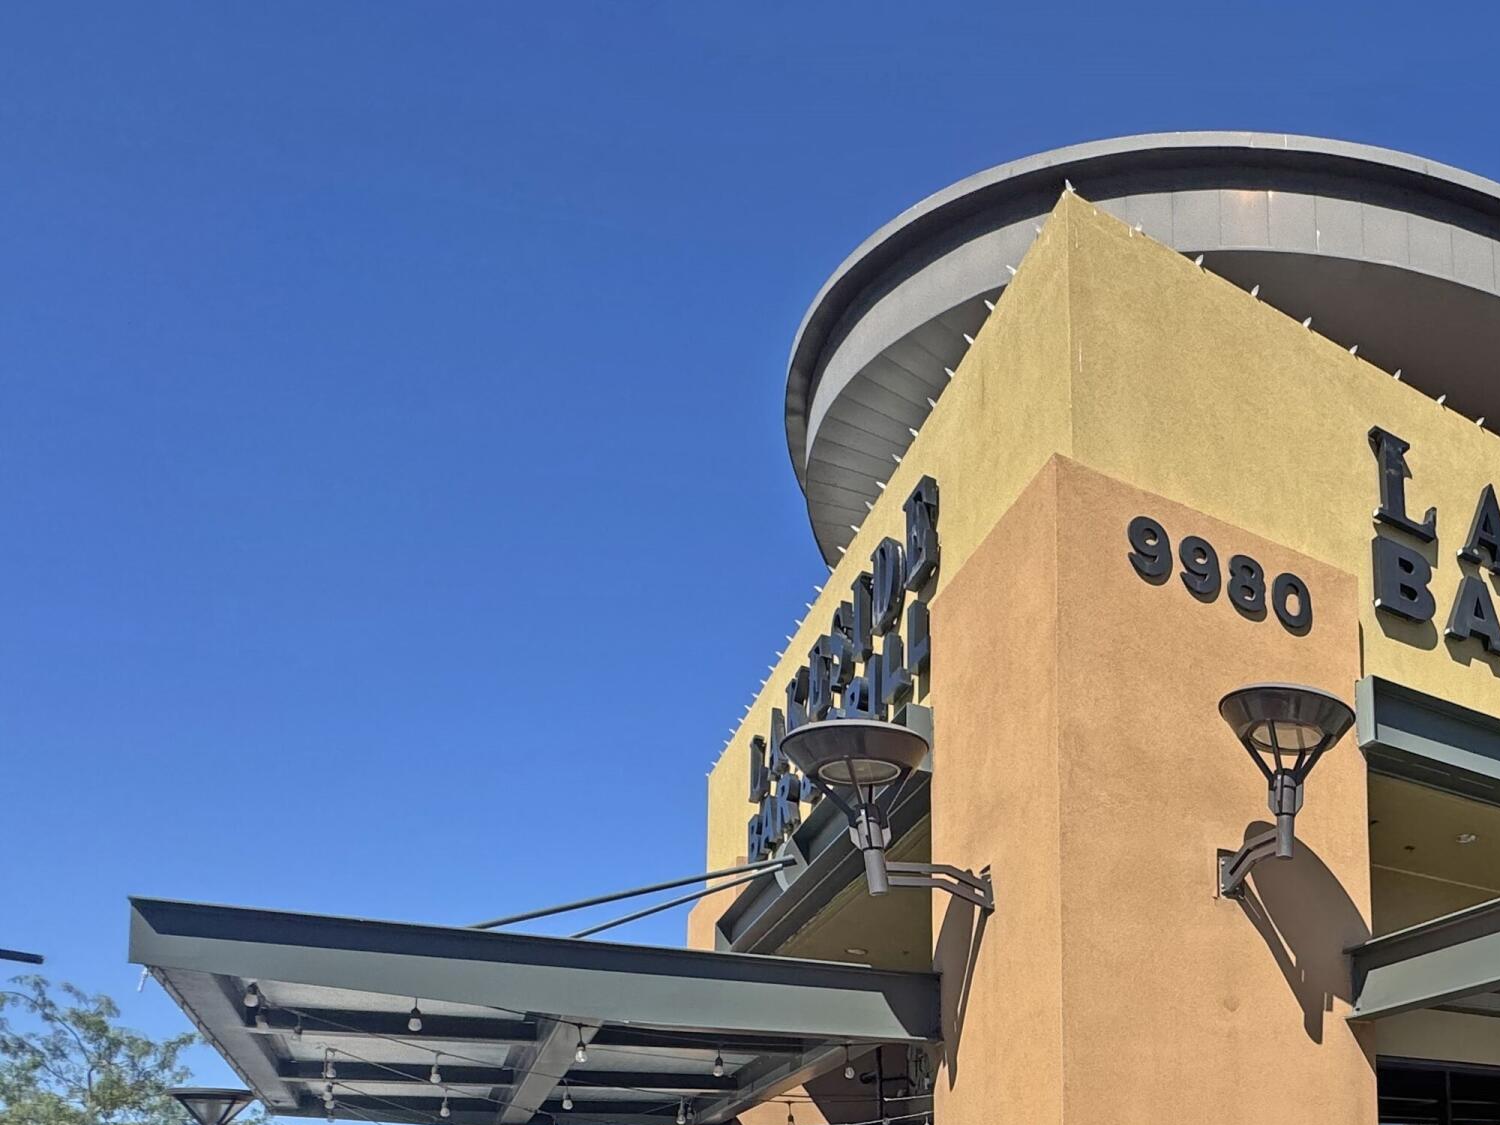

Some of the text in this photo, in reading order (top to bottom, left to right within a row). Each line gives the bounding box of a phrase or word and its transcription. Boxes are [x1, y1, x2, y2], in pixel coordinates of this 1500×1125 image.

[1127, 516, 1313, 634] 9980
[748, 772, 802, 866] BAR
[825, 599, 931, 721] RILL
